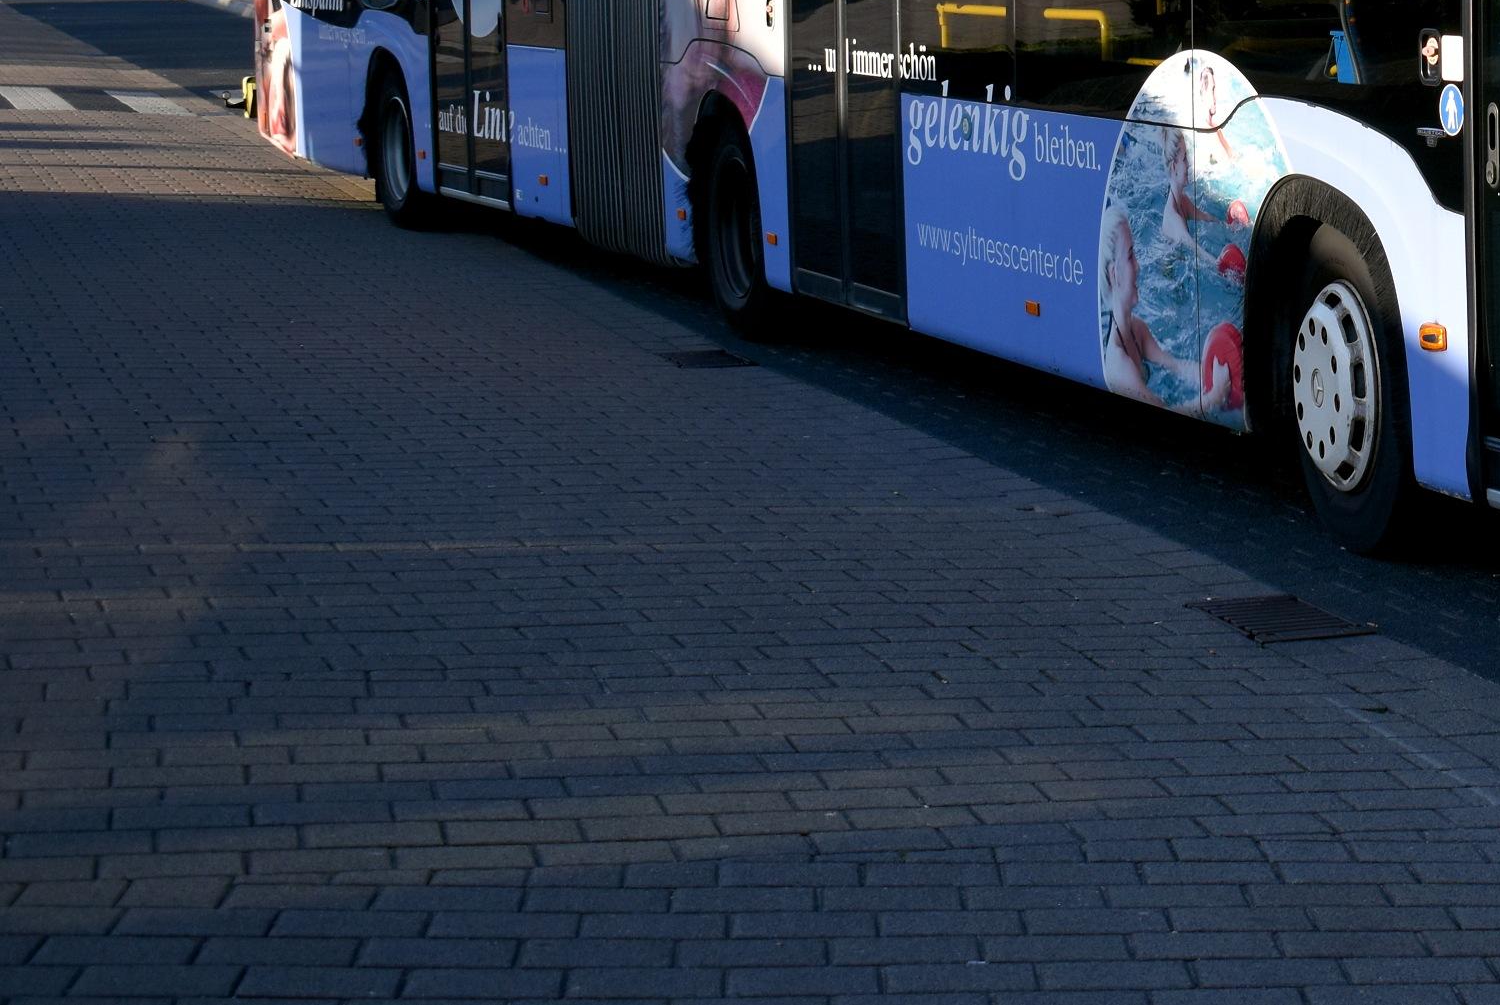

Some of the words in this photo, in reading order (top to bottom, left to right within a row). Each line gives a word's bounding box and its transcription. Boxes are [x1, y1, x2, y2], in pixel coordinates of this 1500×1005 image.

[851, 38, 895, 78] immer
[899, 42, 937, 82] schön
[438, 103, 455, 133] auf
[517, 116, 552, 151] achten
[907, 79, 1031, 182] gelenkig
[1032, 121, 1101, 172] bleiben.
[916, 221, 1084, 286] www.syltnesscenter.de
